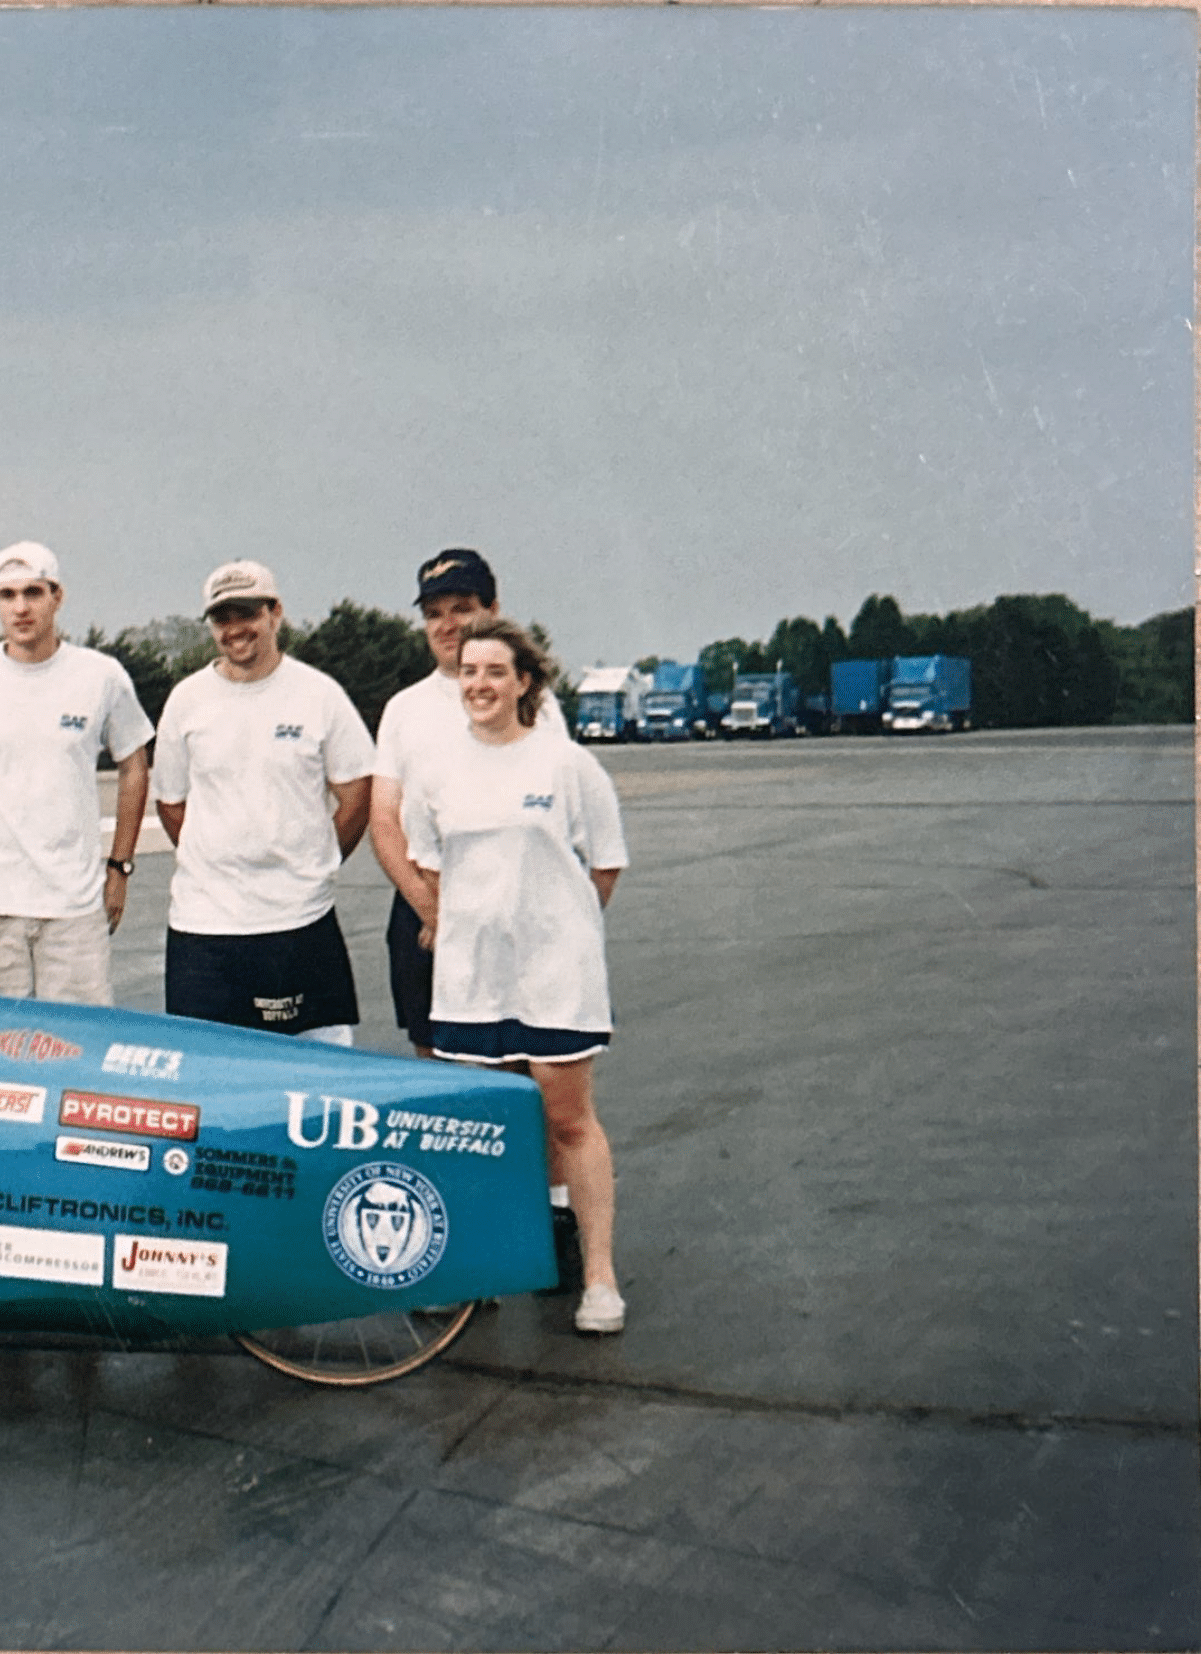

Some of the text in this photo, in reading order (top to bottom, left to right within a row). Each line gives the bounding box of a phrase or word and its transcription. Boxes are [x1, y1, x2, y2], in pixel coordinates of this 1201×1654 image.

[61, 714, 87, 729] SAE
[63, 1100, 195, 1133] PYROTECT
[284, 1091, 379, 1150] UB
[386, 1110, 506, 1139] UNIVERSITY
[82, 1144, 147, 1163] ANDREW'S
[195, 1147, 278, 1168] SOMMERS
[382, 1131, 506, 1158] AT BUFFALO
[195, 1162, 296, 1185] EQUIPMENT
[121, 1240, 219, 1273] JOHNNY'S
